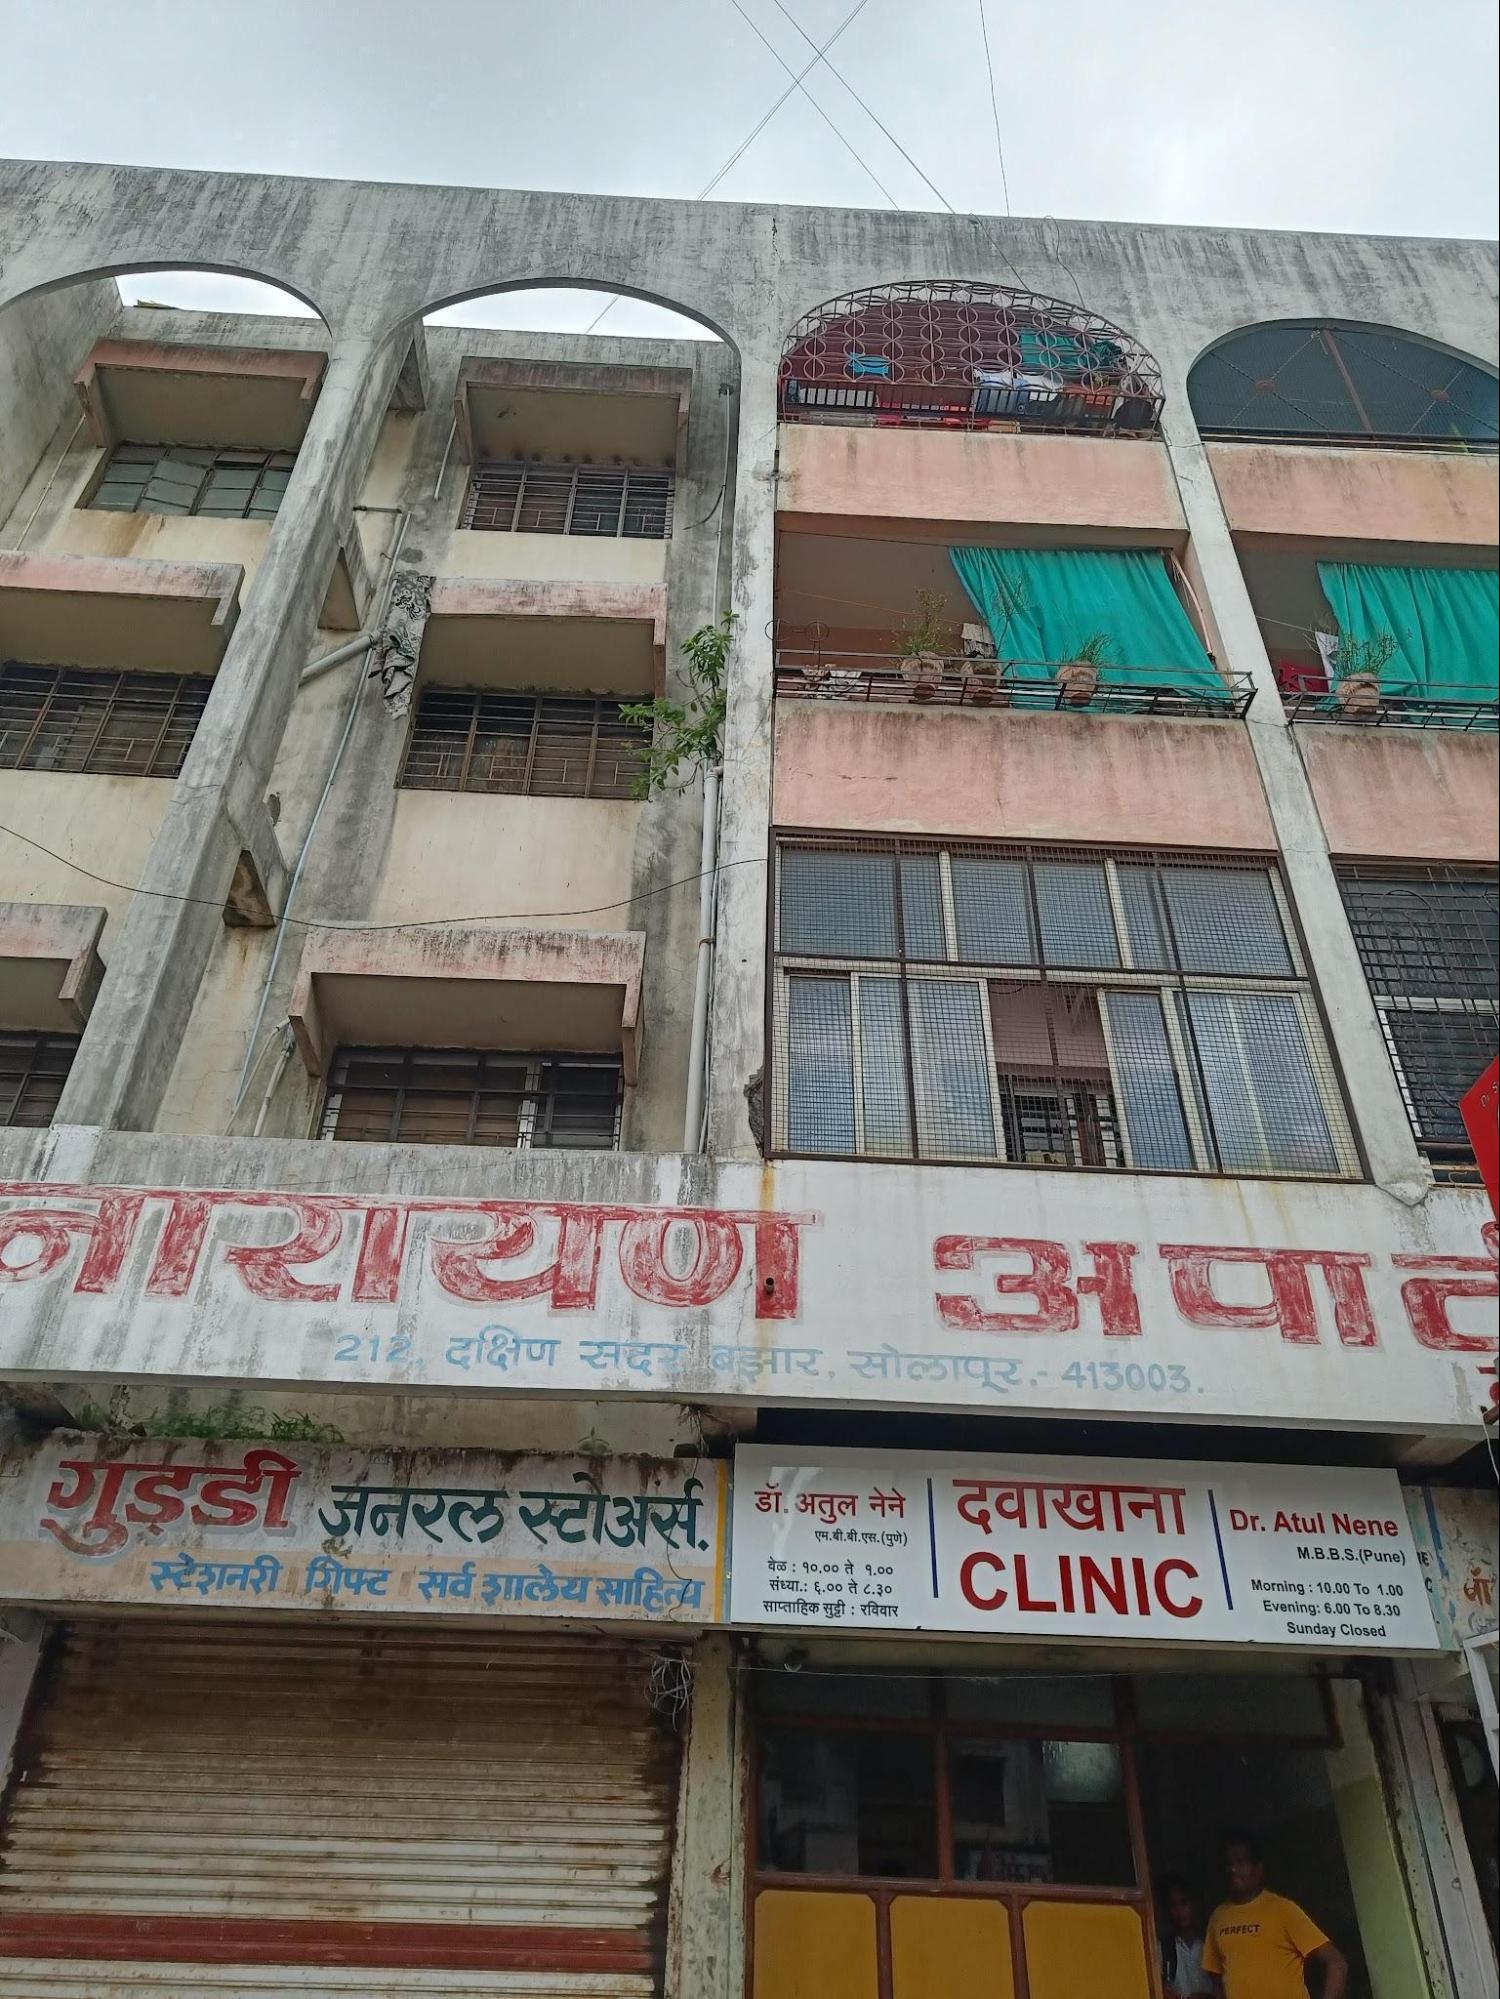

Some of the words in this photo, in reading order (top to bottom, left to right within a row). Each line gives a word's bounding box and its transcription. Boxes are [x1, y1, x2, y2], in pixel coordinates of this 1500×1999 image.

[444, 1324, 561, 1373] दक्षिण
[754, 1482, 789, 1514] डॉ.
[795, 1492, 859, 1524] अतुल
[868, 1486, 906, 1519] नेने
[952, 1479, 1186, 1535] दवाखाना
[317, 1485, 509, 1544] जनरल
[1229, 1509, 1266, 1532] Dr.
[1274, 1511, 1325, 1534] Atul
[1331, 1513, 1398, 1537] Nene
[1296, 1546, 1406, 1567] M.B.B.S.(Pune)
[844, 1559, 854, 1576] ते
[150, 1552, 284, 1595] स्टेशनरी
[418, 1561, 476, 1600] सर्व
[480, 1563, 592, 1607] शालेय
[595, 1567, 706, 1613] साहित्य
[848, 1578, 858, 1594] ते
[960, 1551, 1203, 1618] CLINIC
[1251, 1579, 1305, 1596] Morning
[1317, 1582, 1350, 1595] 10.00
[1353, 1583, 1370, 1595] To
[1377, 1584, 1404, 1597] 1.00
[763, 1598, 820, 1616] साप्ताहिक
[860, 1601, 898, 1618] रविवार
[1263, 1600, 1320, 1616] Evening:
[1324, 1602, 1351, 1615] 6.00
[1353, 1603, 1370, 1616] To
[1374, 1604, 1401, 1617] 8.30
[1286, 1622, 1336, 1639] Sunday
[1341, 1624, 1386, 1638] Closed
[1219, 1923, 1262, 1937] PERFECT
